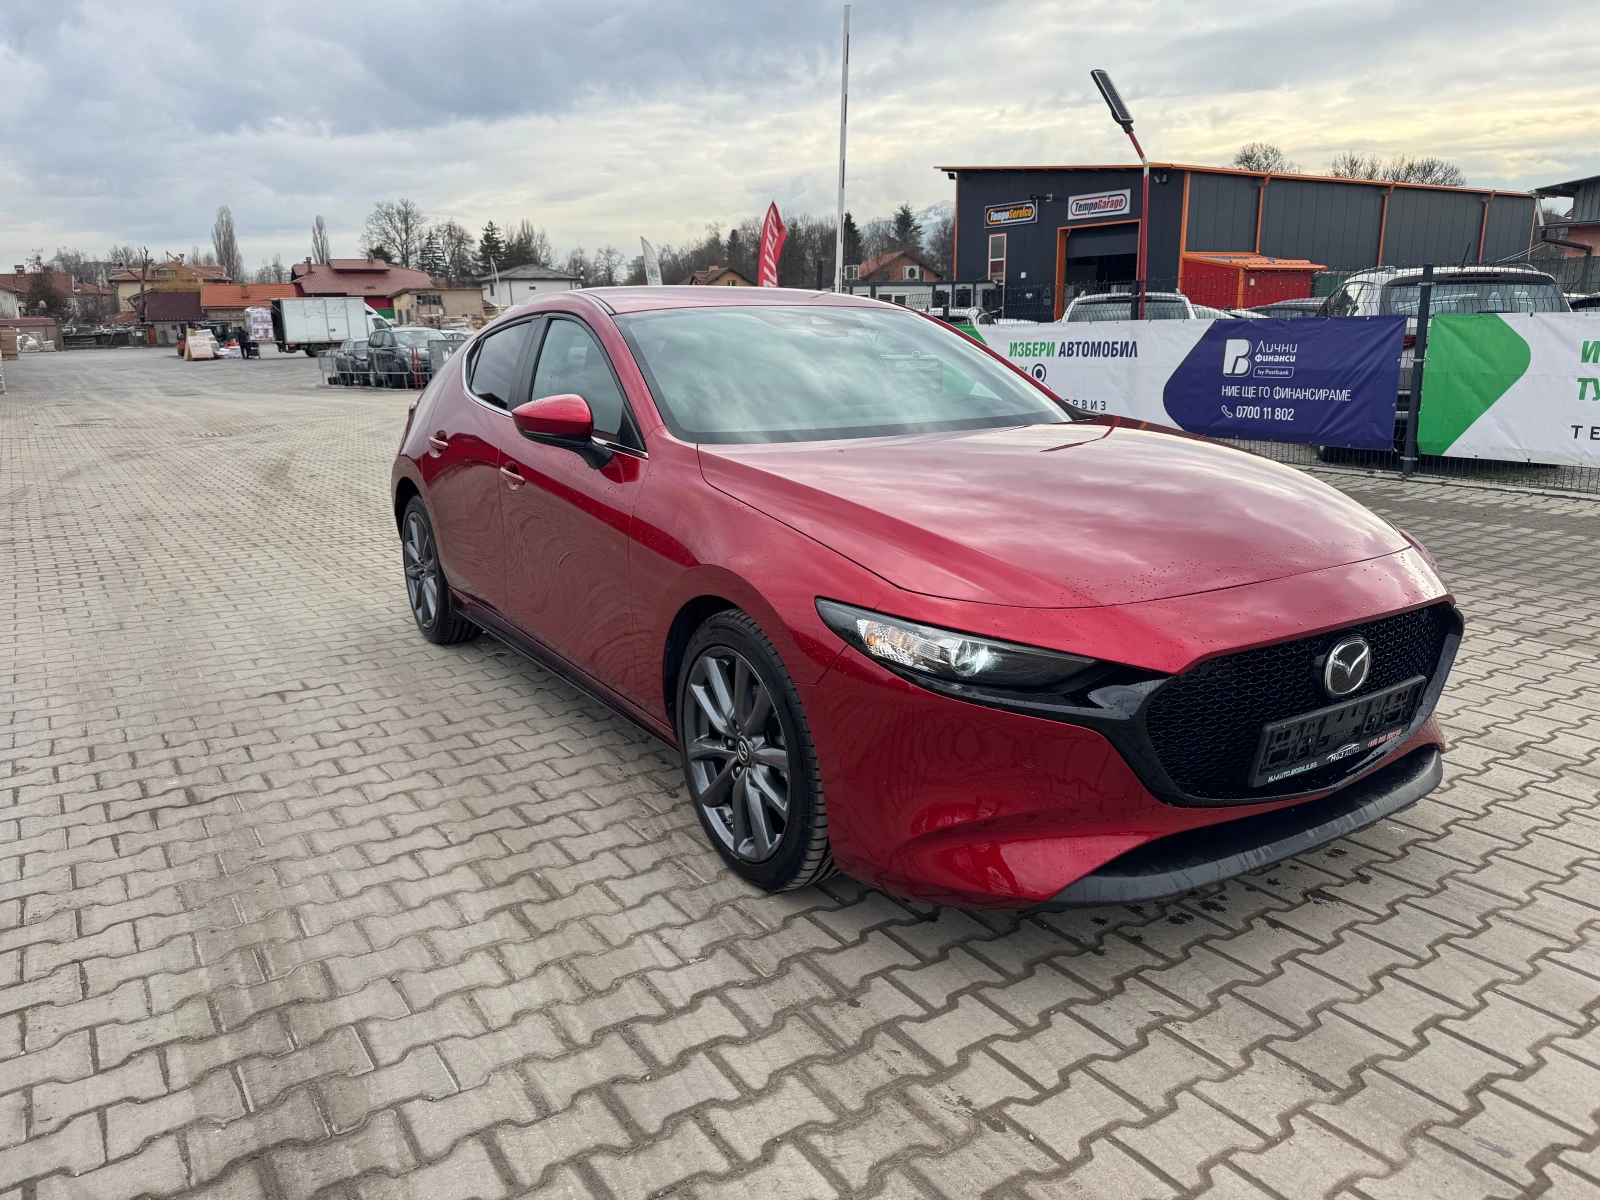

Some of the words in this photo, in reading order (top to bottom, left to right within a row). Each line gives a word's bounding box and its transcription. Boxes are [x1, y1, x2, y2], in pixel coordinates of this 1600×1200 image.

[990, 206, 1033, 223] TempoService
[1075, 198, 1124, 215] TempoGarage
[1008, 341, 1056, 358] ИЗБЕРИ
[1058, 341, 1138, 358] АВТОМОБИЛ
[1255, 340, 1298, 353] Лични
[1221, 385, 1240, 397] НИЕ
[1242, 386, 1257, 398] ЩЕ
[1258, 386, 1271, 398] ГО
[1273, 386, 1352, 402] ФИНАНСИРАМЕ
[1236, 405, 1260, 419] 0700
[1262, 407, 1272, 420] 11
[1274, 408, 1295, 421] 802
